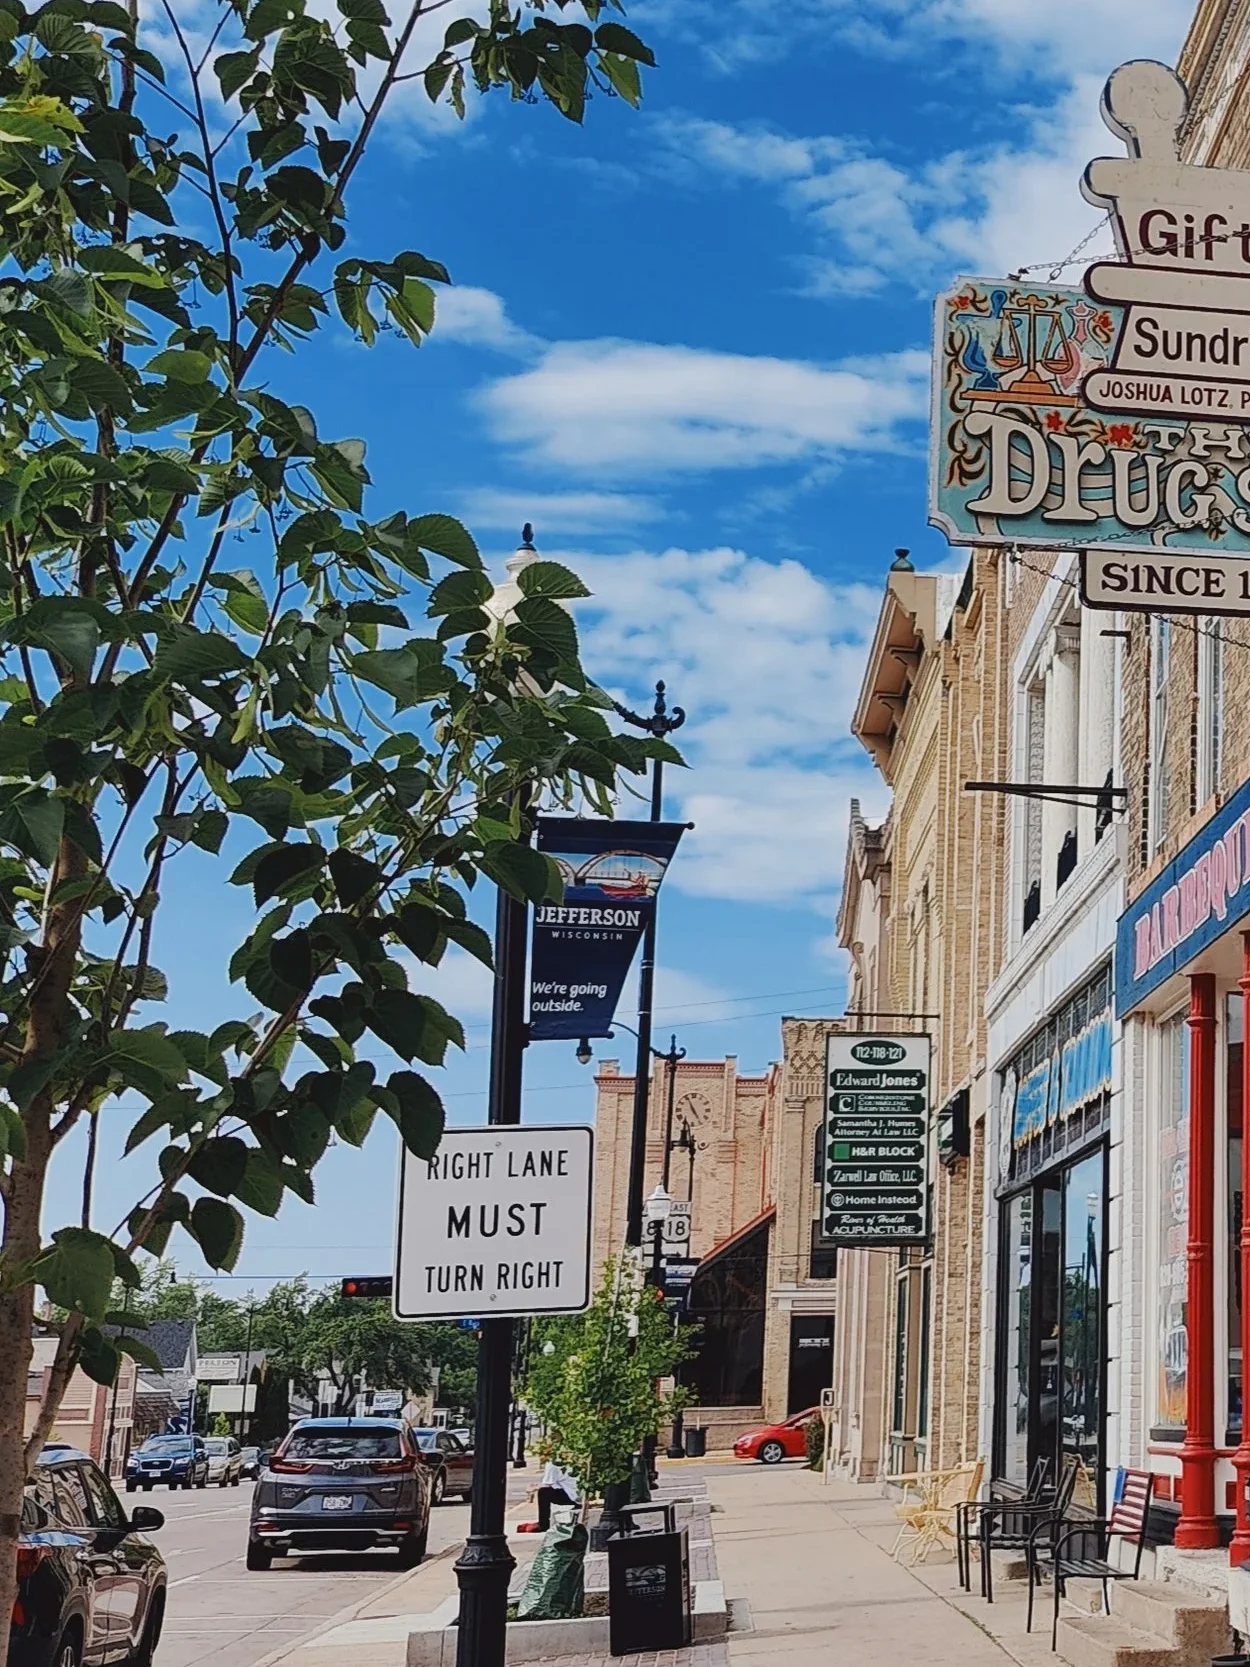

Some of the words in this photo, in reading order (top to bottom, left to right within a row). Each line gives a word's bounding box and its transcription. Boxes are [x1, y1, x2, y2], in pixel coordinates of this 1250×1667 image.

[1099, 379, 1174, 403] JOSHUA
[1101, 563, 1226, 599] SINCE
[536, 906, 640, 928] JEFFERSON
[551, 930, 624, 942] WISCONSIN
[532, 981, 567, 996] We're
[570, 983, 608, 999] going
[532, 997, 584, 1013] outside.
[836, 1073, 880, 1086] Edward
[880, 1073, 918, 1088] Jones
[837, 1119, 877, 1127] Samantha
[834, 1128, 870, 1137] Attorney
[903, 1128, 919, 1136] LLC
[851, 1147, 876, 1156] H&R
[878, 1147, 916, 1156] BLOCK
[426, 1152, 494, 1181] RIGHT
[506, 1149, 570, 1178] LANE
[864, 1170, 879, 1182] Law
[845, 1196, 876, 1204] Home
[877, 1195, 917, 1204] Instead
[447, 1202, 548, 1239] MUST
[668, 1220, 685, 1236] 18
[832, 1225, 916, 1235] ACUPUNCTURE
[425, 1264, 485, 1294] TURN
[498, 1261, 565, 1291] RIGHT
